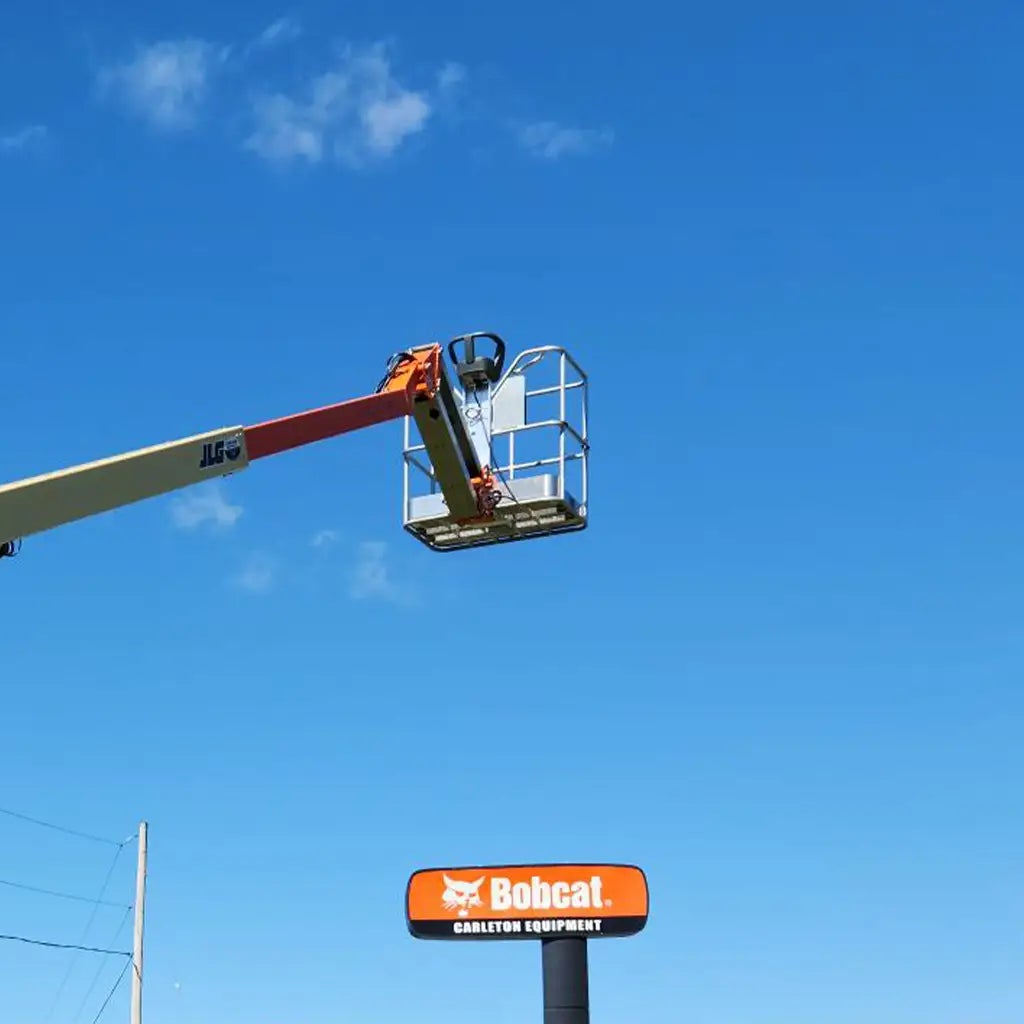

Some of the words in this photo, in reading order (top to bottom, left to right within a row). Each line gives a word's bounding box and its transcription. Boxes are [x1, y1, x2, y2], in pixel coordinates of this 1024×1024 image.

[199, 440, 225, 468] JLG
[490, 876, 603, 910] Bobcat
[453, 921, 521, 933] CARLETON
[525, 919, 602, 932] EQUIPMENT
